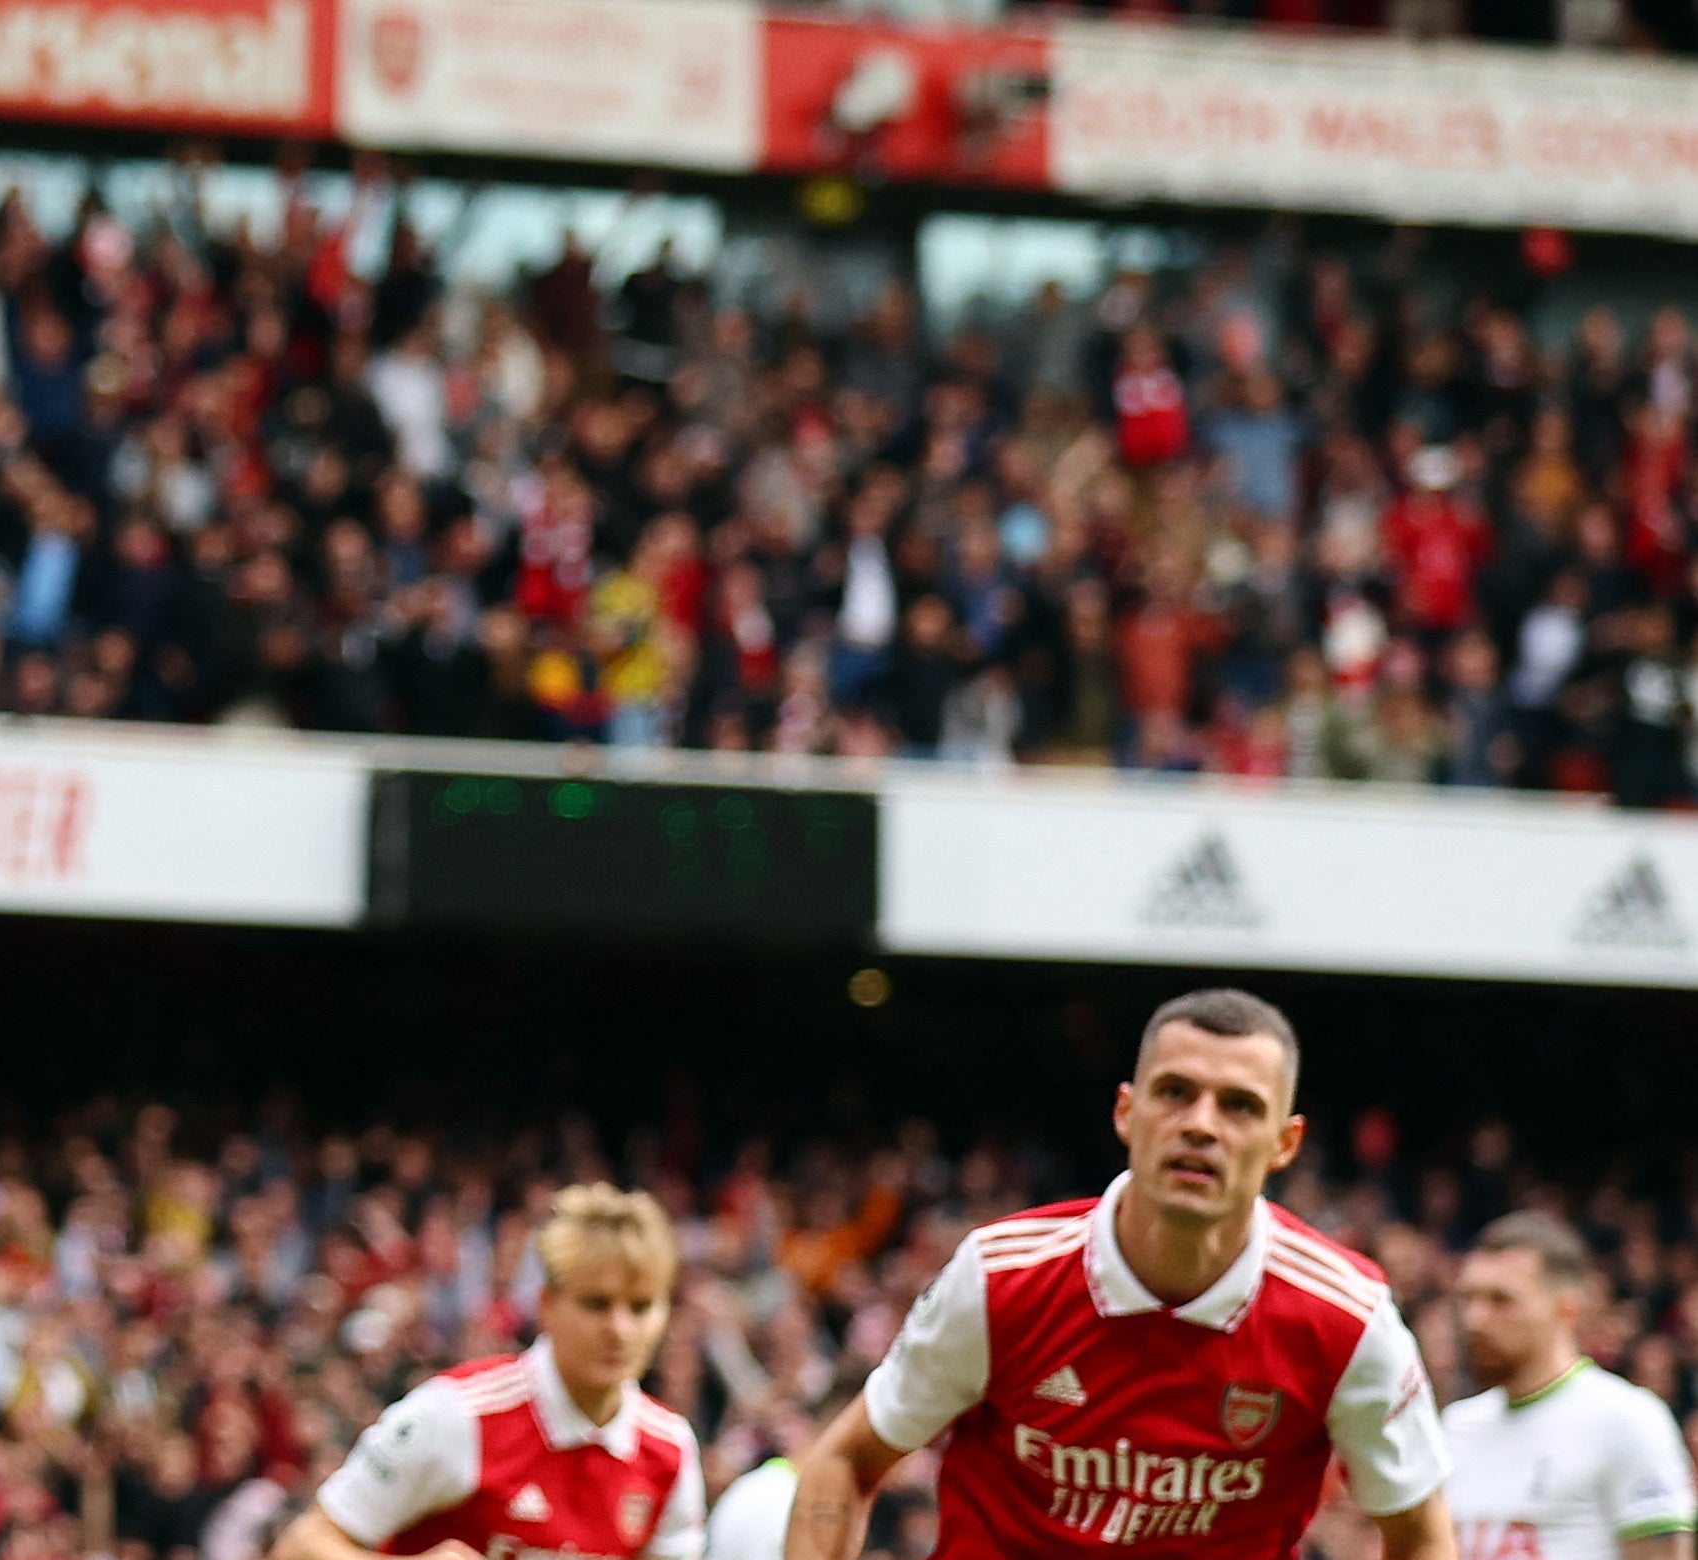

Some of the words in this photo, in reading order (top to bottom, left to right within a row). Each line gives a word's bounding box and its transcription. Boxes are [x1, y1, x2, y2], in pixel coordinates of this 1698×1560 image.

[1013, 1422, 1263, 1502] Emirates
[1047, 1486, 1107, 1533] FLY
[1100, 1497, 1221, 1546] BETTER
